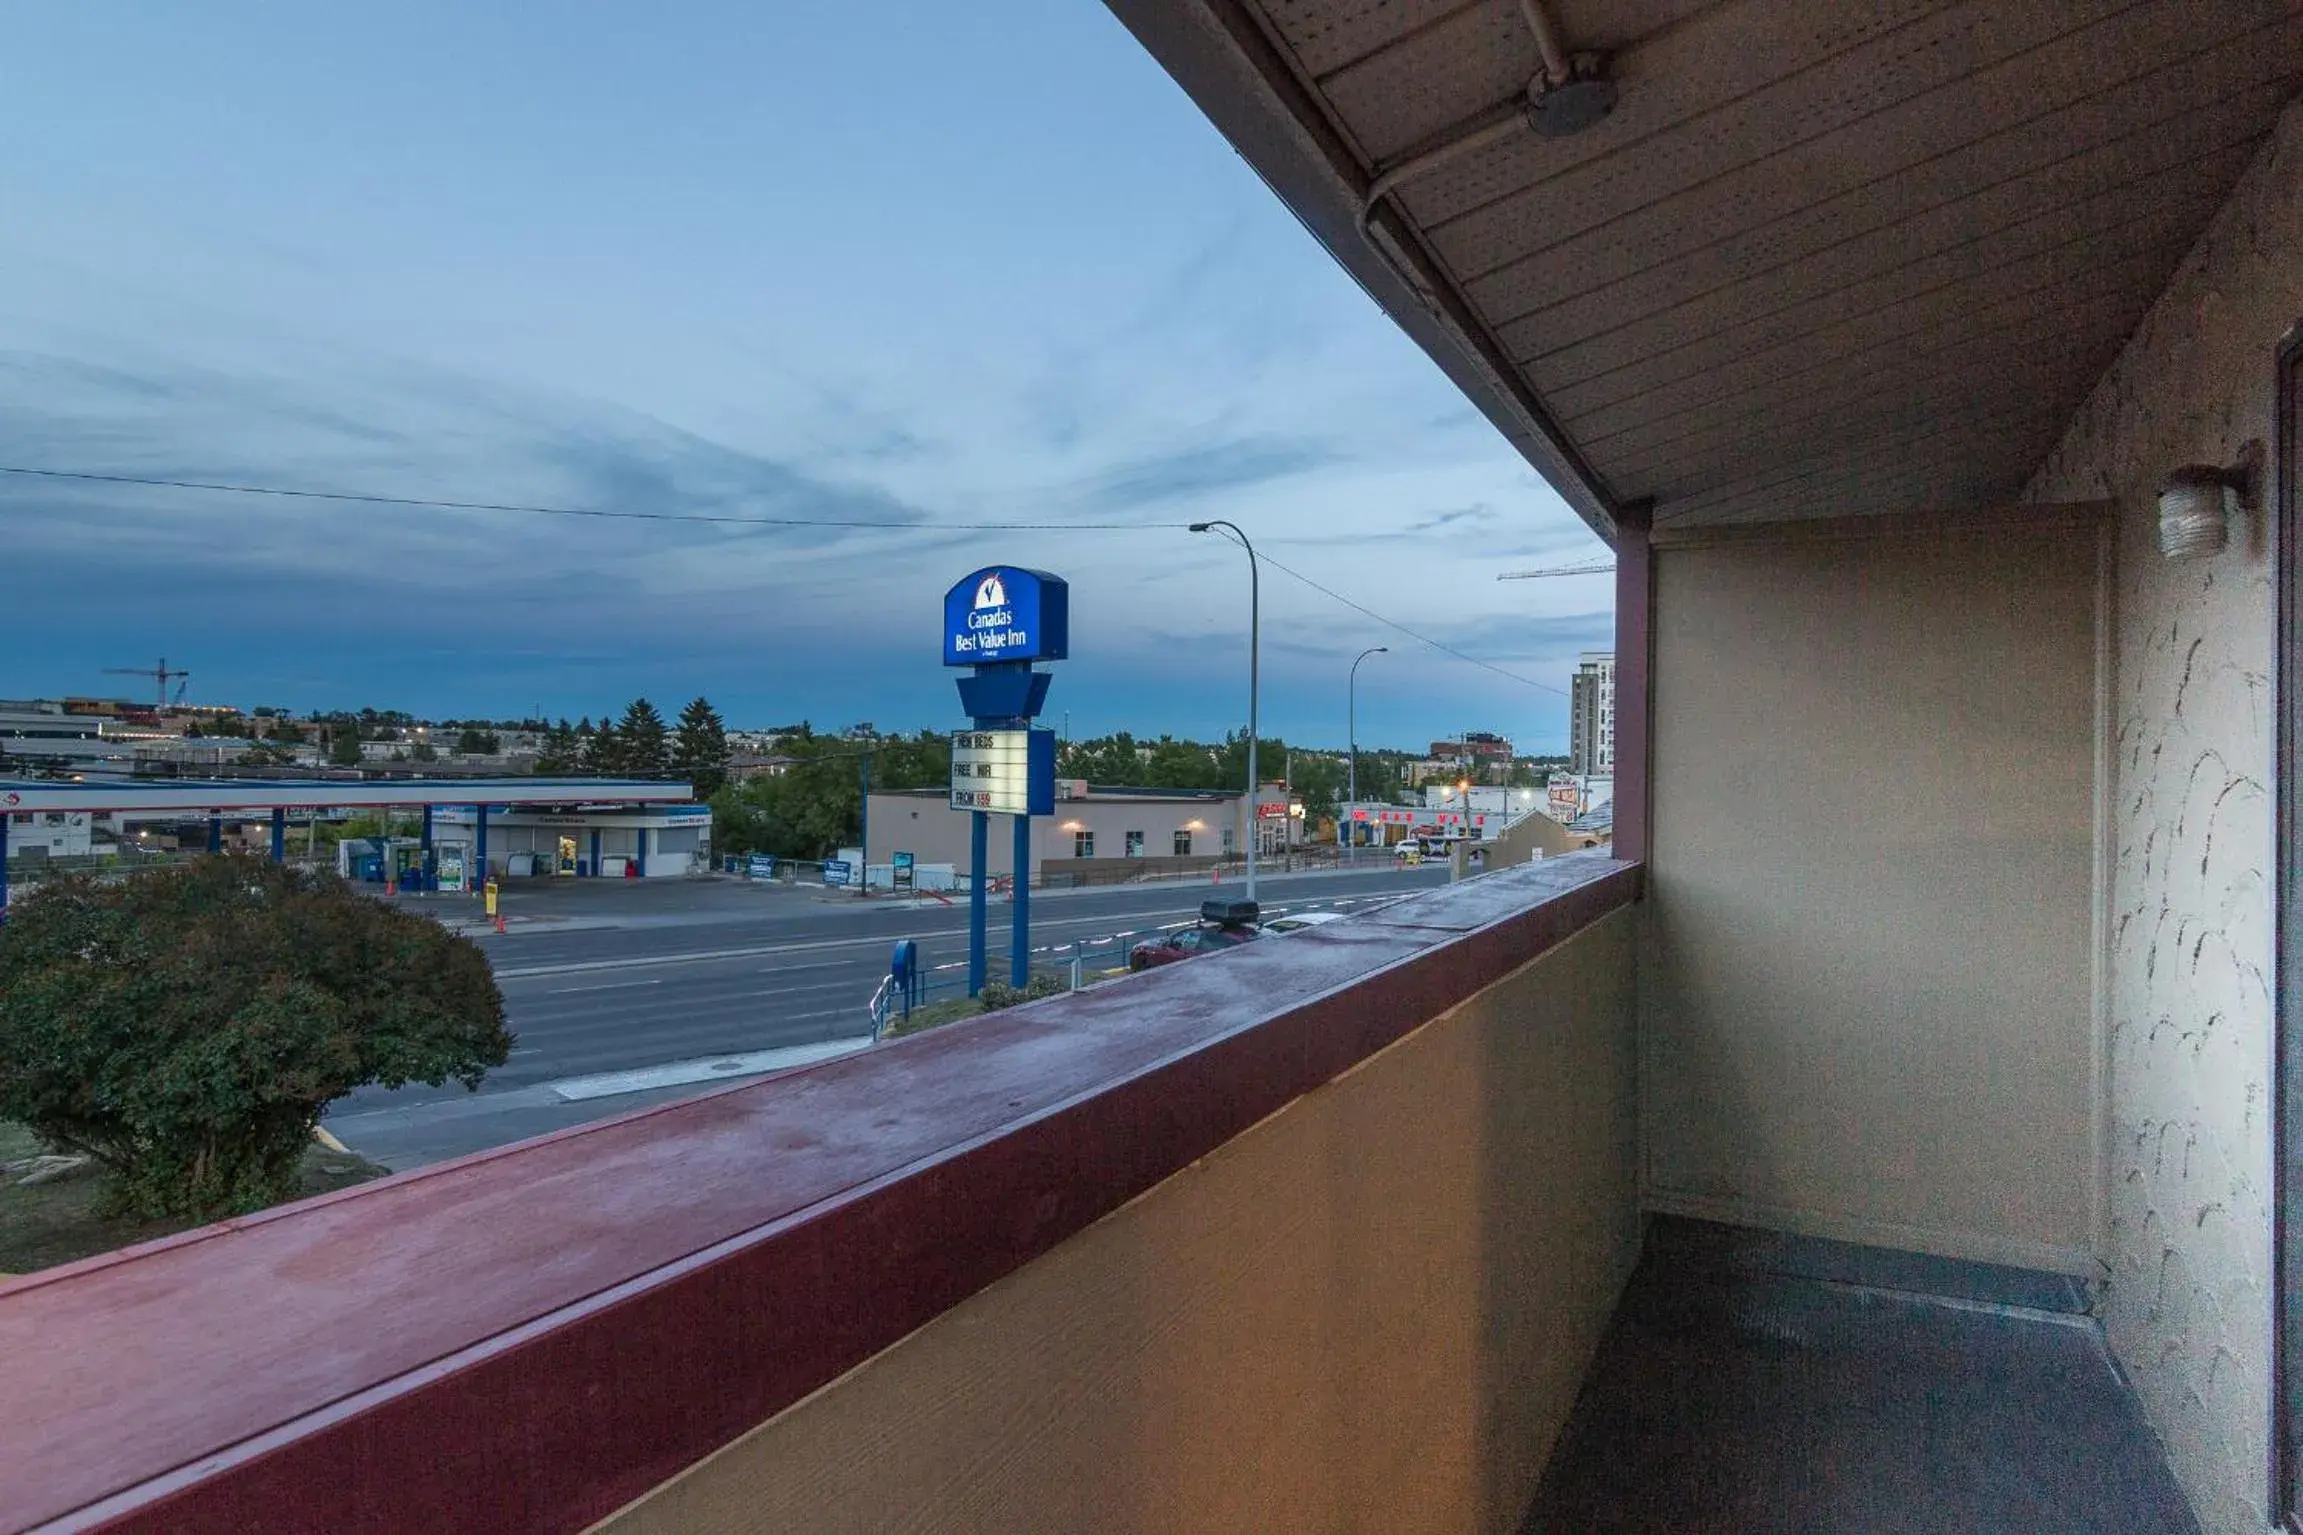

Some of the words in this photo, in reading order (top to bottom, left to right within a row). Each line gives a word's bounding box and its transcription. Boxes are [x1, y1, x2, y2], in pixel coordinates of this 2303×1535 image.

[955, 633, 977, 652] Best
[978, 629, 1006, 648] Value
[1008, 628, 1026, 645] Inn
[954, 763, 971, 777] FREE
[956, 791, 974, 804] FROM
